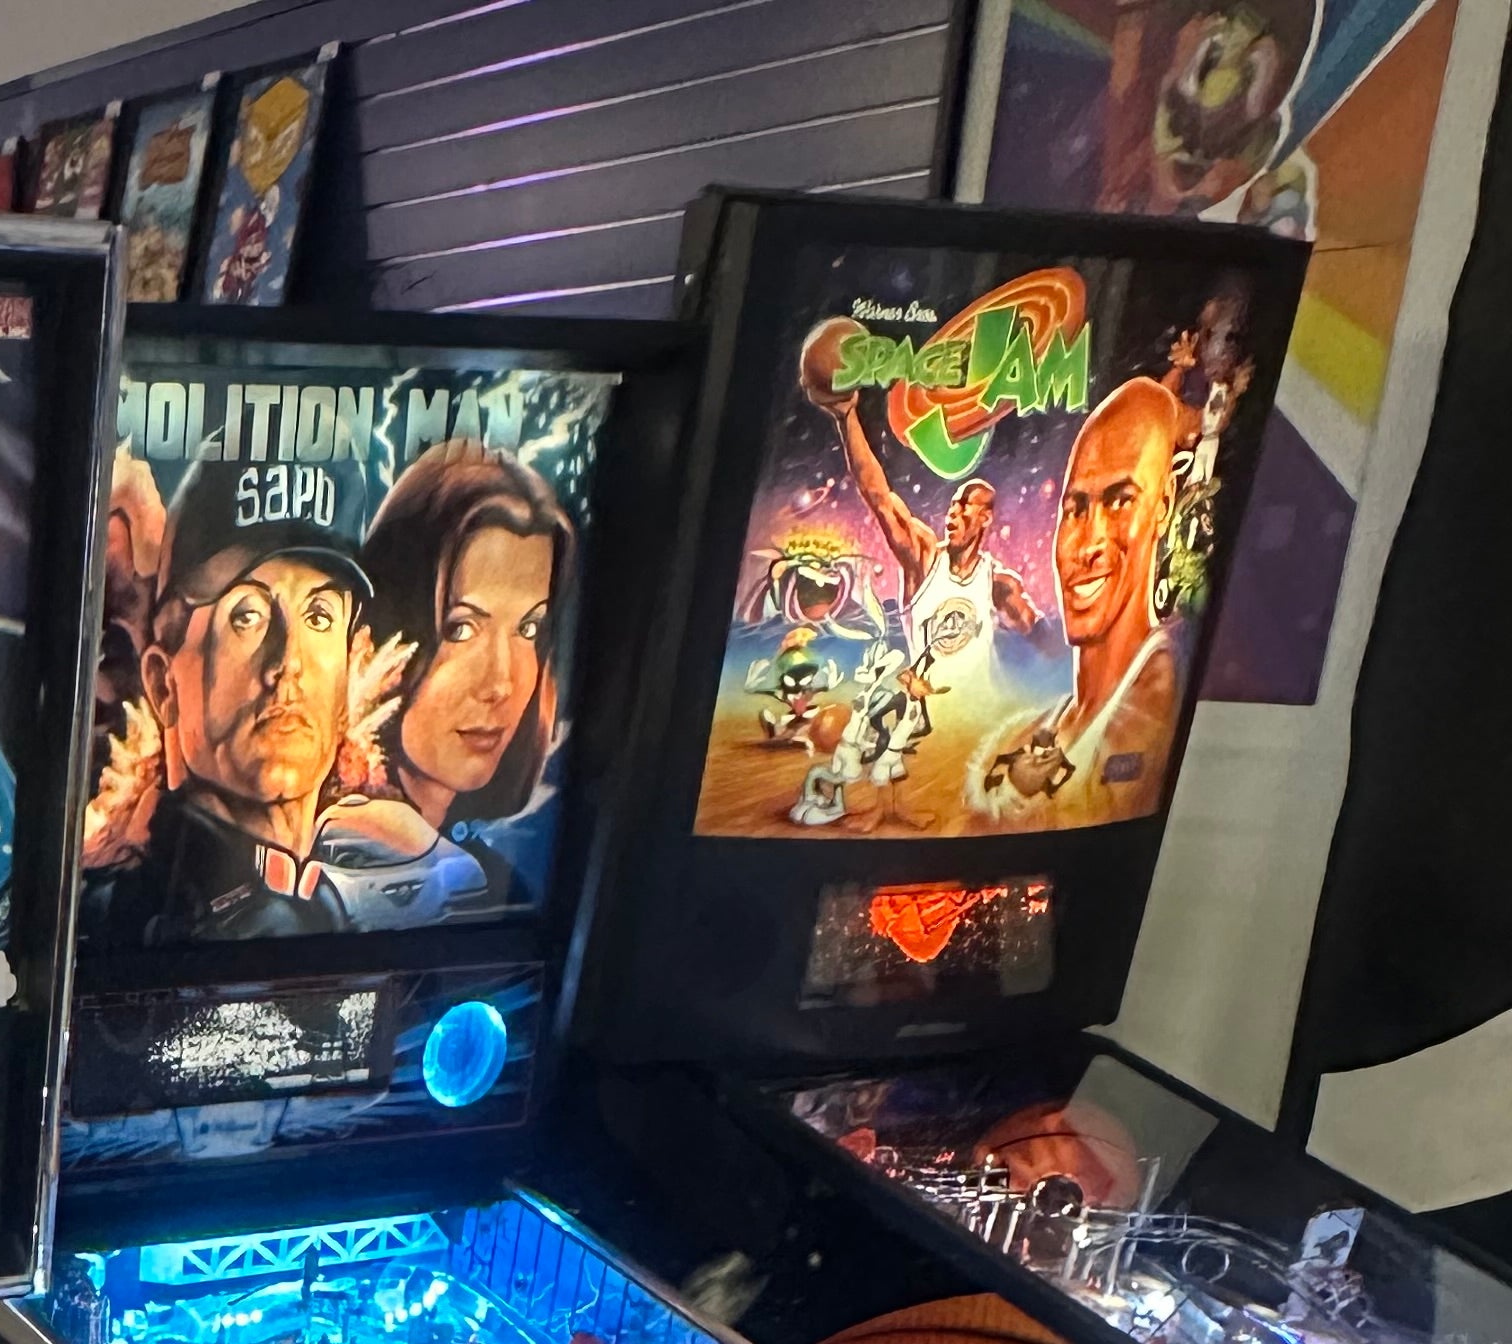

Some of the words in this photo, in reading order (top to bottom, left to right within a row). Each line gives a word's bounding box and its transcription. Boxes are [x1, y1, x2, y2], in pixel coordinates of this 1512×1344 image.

[404, 385, 525, 461] MAN
[832, 333, 972, 392] SPACE
[905, 305, 1090, 480] JAM
